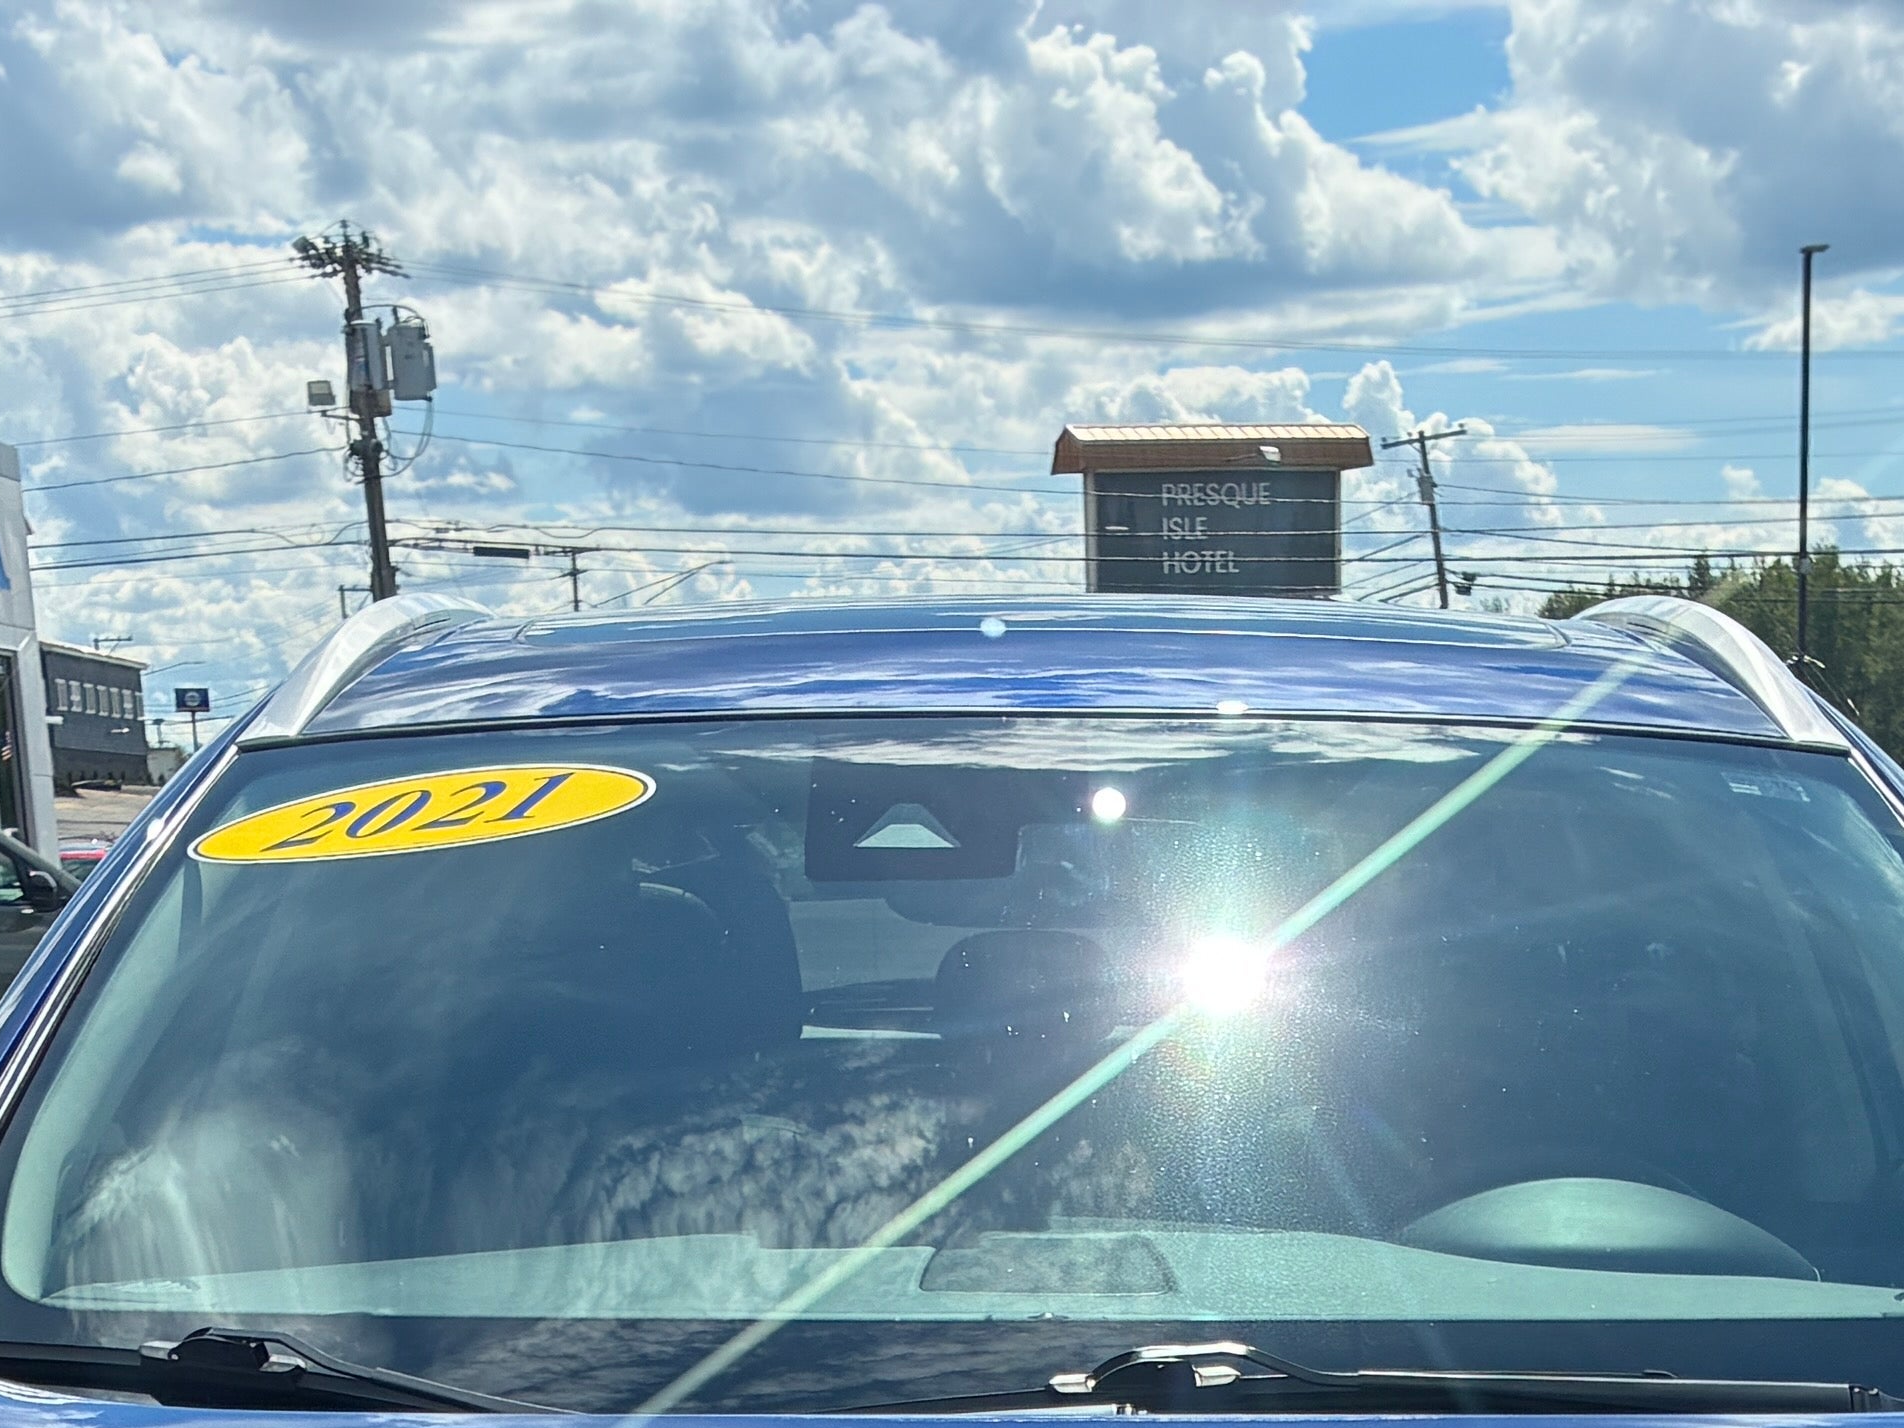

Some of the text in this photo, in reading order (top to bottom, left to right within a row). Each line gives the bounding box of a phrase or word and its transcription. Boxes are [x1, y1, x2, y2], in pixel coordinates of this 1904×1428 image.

[1162, 482, 1271, 509] PRESQUE
[1162, 517, 1208, 540] ISLE
[1163, 550, 1240, 574] HOTEL
[259, 772, 577, 853] 2021
